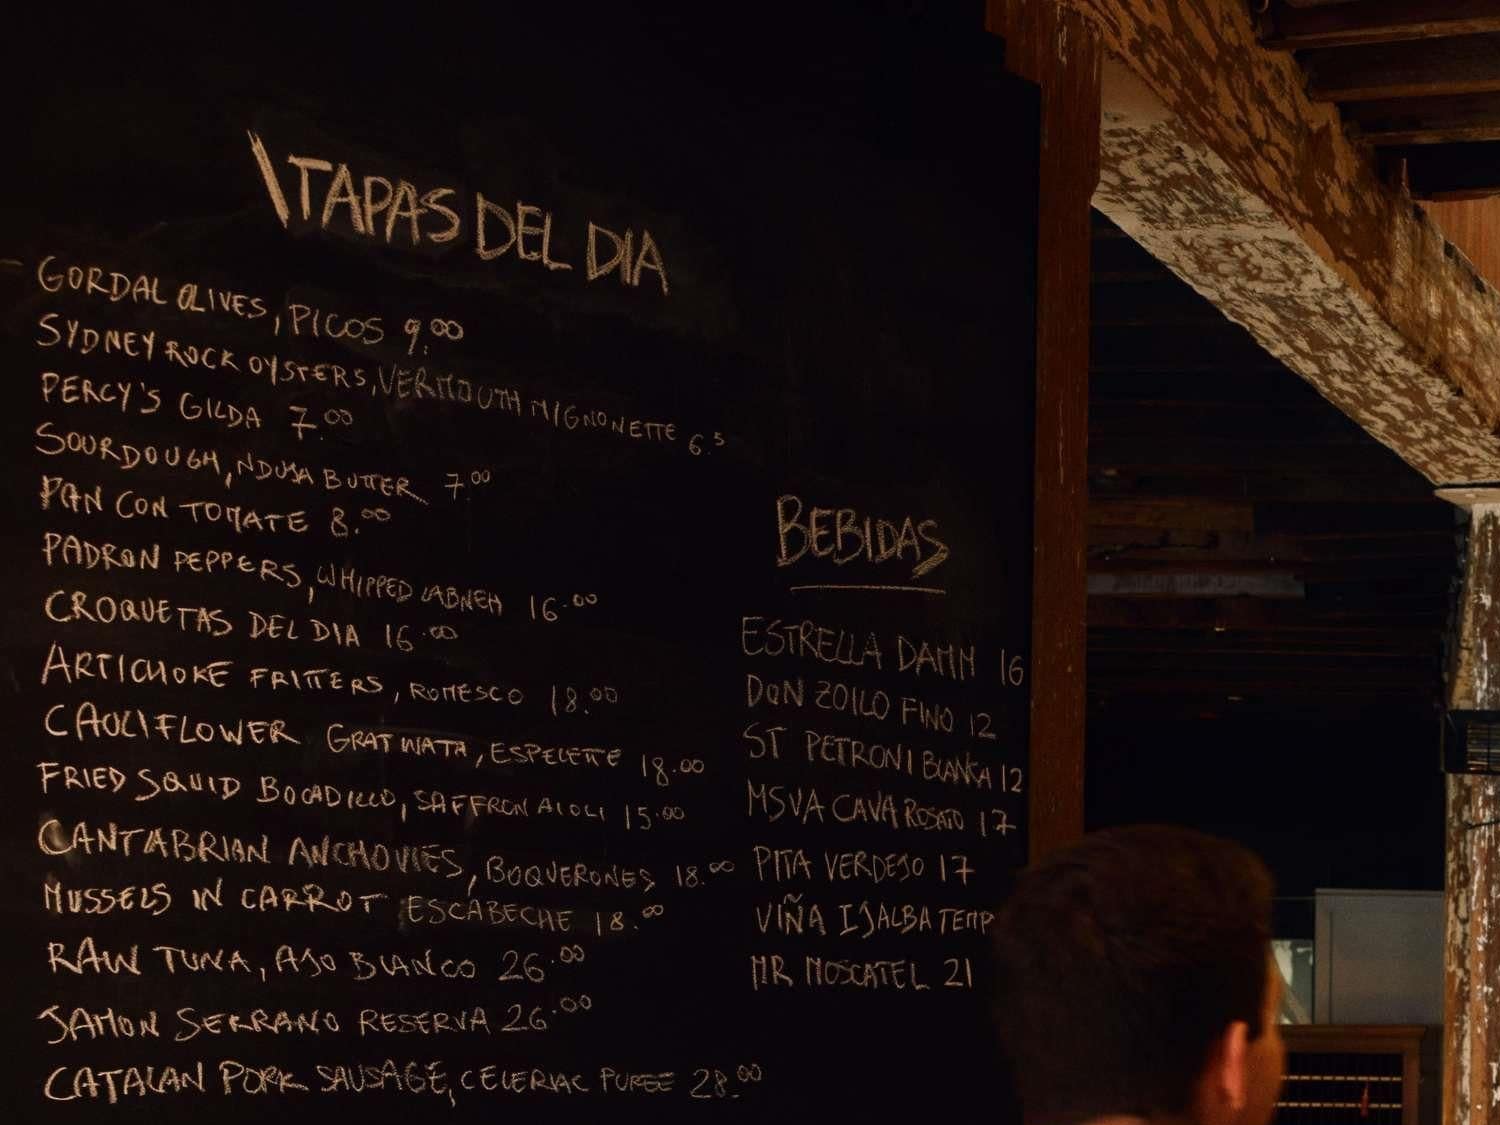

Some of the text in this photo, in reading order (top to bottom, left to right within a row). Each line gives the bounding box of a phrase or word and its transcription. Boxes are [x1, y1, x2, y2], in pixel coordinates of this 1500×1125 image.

[476, 191, 573, 270] DEL
[586, 219, 671, 295] DIA
[37, 256, 167, 305] GORDAL
[289, 304, 385, 344] PICOS
[36, 313, 155, 362] SYDNEY
[165, 339, 240, 371] ROCK
[376, 362, 522, 416] VERMOUTH
[530, 399, 677, 441] MIGNONETTE
[41, 373, 161, 413] PERCY'S
[179, 393, 261, 428] GILDA
[41, 475, 103, 513] PAN
[115, 490, 169, 519] CON
[179, 502, 309, 533] TOMATE
[323, 468, 430, 506] BUTTER
[776, 495, 950, 578] BEBIDAS
[41, 531, 160, 571] PADRON
[317, 563, 414, 602] WHIPPED
[421, 585, 503, 616] LABNEH
[530, 593, 598, 622] 16.00
[44, 589, 458, 652] CROQUETAS DEL DIA 16.00
[741, 615, 883, 670] ESTRELLA
[1000, 648, 1024, 687] 16
[41, 641, 234, 688] ARTICHOKE
[409, 681, 523, 705] ROMESCO
[551, 684, 618, 717] 18.00
[746, 673, 997, 740] DON ZOILO FINO 12
[45, 702, 301, 746] CAULIFLOWER
[491, 743, 623, 768] ESPELETTE
[641, 752, 705, 787] 18.00
[741, 721, 788, 760] ST
[804, 729, 912, 775] PETRONI
[1001, 761, 1023, 793] 12
[37, 762, 127, 794] FRIED
[134, 769, 241, 801] SQUID
[415, 789, 529, 817] SAFFRON
[537, 798, 606, 822] AIOLI
[624, 803, 685, 831] 15.00
[746, 779, 824, 824] MSVA
[832, 791, 899, 829] CAVA
[977, 808, 1016, 837] 17
[38, 819, 270, 863] CANTABRIAN
[676, 859, 735, 888] 18.00
[752, 845, 975, 886] PITA VERDEJO 17
[43, 877, 664, 936] MUSSELS IN CARROT ESCABECHE 18.00
[756, 892, 828, 935] VIÑA
[48, 937, 141, 976] RAW
[275, 944, 337, 977] AJO
[349, 950, 476, 980] BLANCO
[498, 944, 585, 983] 26.00
[751, 954, 973, 991] MR MOSCATEL 21
[37, 995, 593, 1044] JAMON SERRANO RESERVA 26.00
[44, 1061, 206, 1104] CATALAN
[219, 1060, 309, 1095] PORK
[460, 1065, 590, 1094] CELERIAC
[600, 1067, 674, 1093] PUREE
